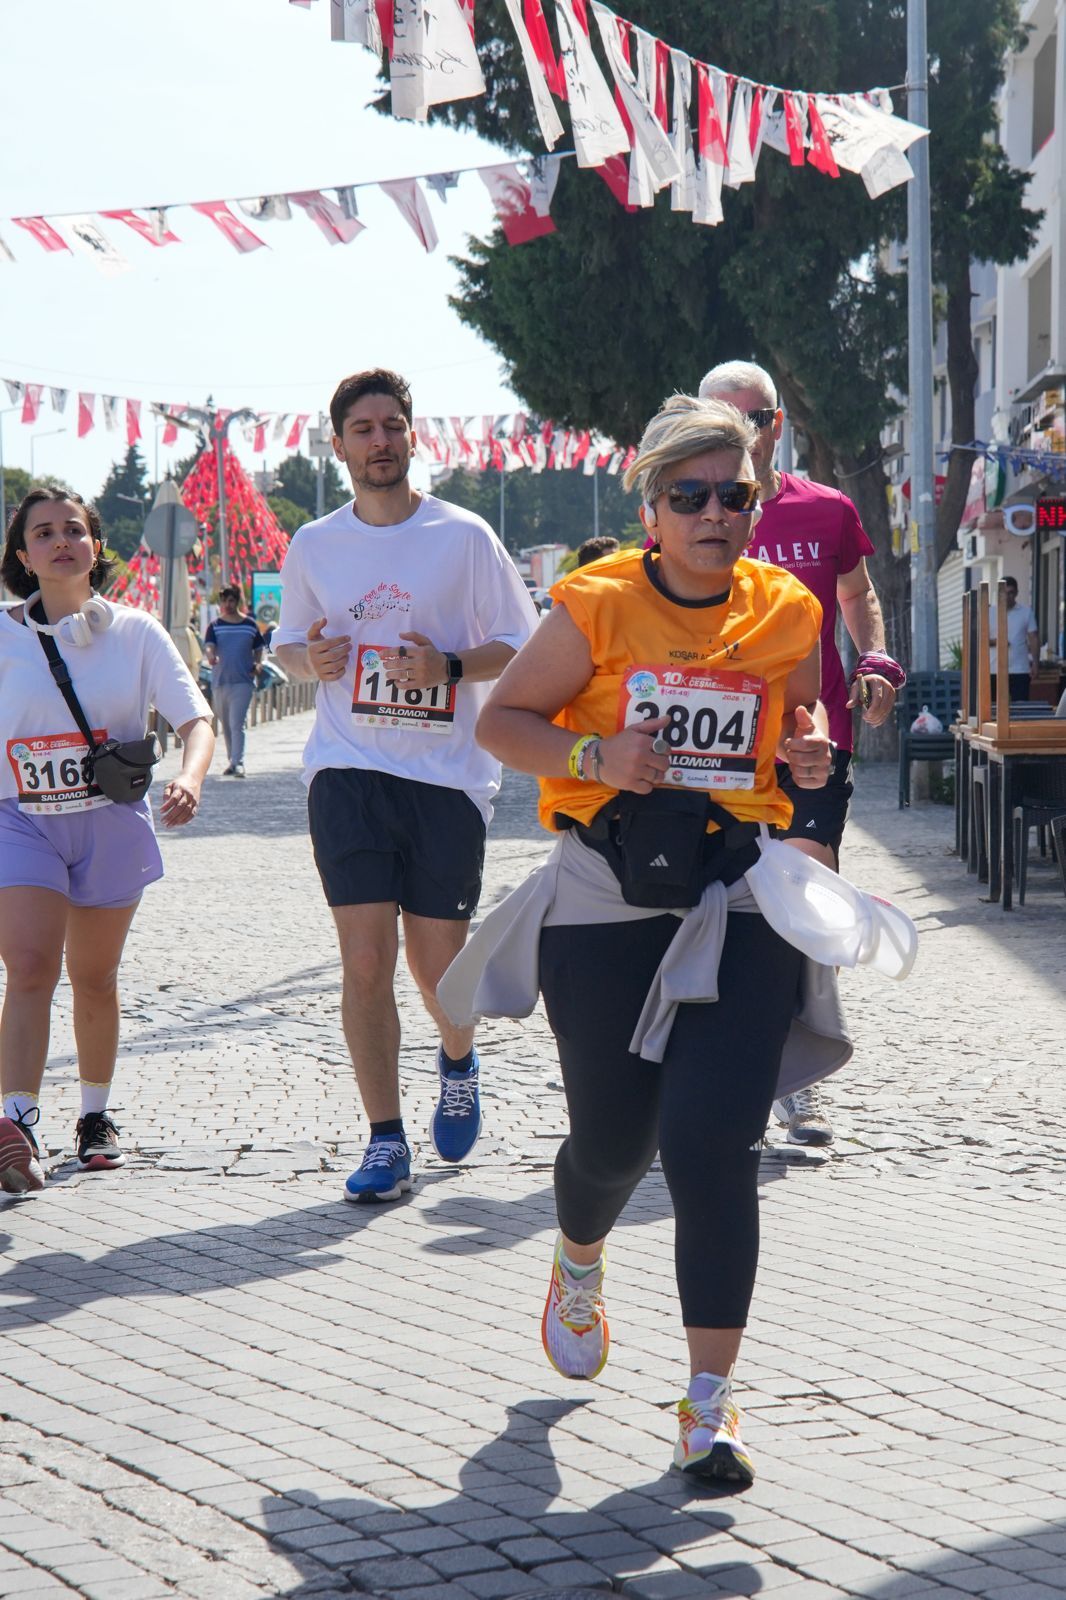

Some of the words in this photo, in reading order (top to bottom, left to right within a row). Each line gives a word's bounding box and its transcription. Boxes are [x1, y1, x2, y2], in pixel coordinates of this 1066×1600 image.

[662, 671, 688, 686] 10K
[378, 706, 429, 718] SALOMON
[41, 791, 88, 802] SALOMON
